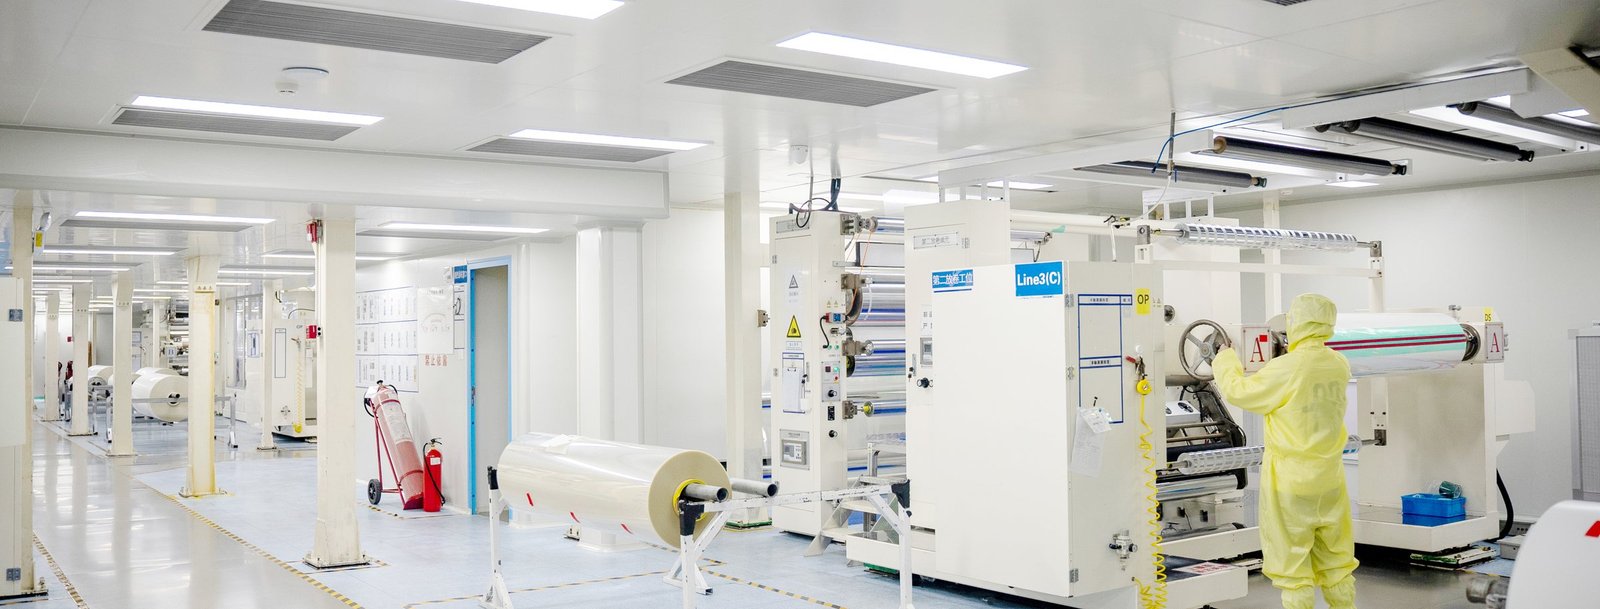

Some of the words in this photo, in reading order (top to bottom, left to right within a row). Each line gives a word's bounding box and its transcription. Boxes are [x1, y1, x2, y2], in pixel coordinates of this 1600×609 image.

[1016, 271, 1061, 286] Line3(C)
[1137, 294, 1150, 305] OP
[1250, 336, 1265, 362] A
[1490, 332, 1500, 353] A
